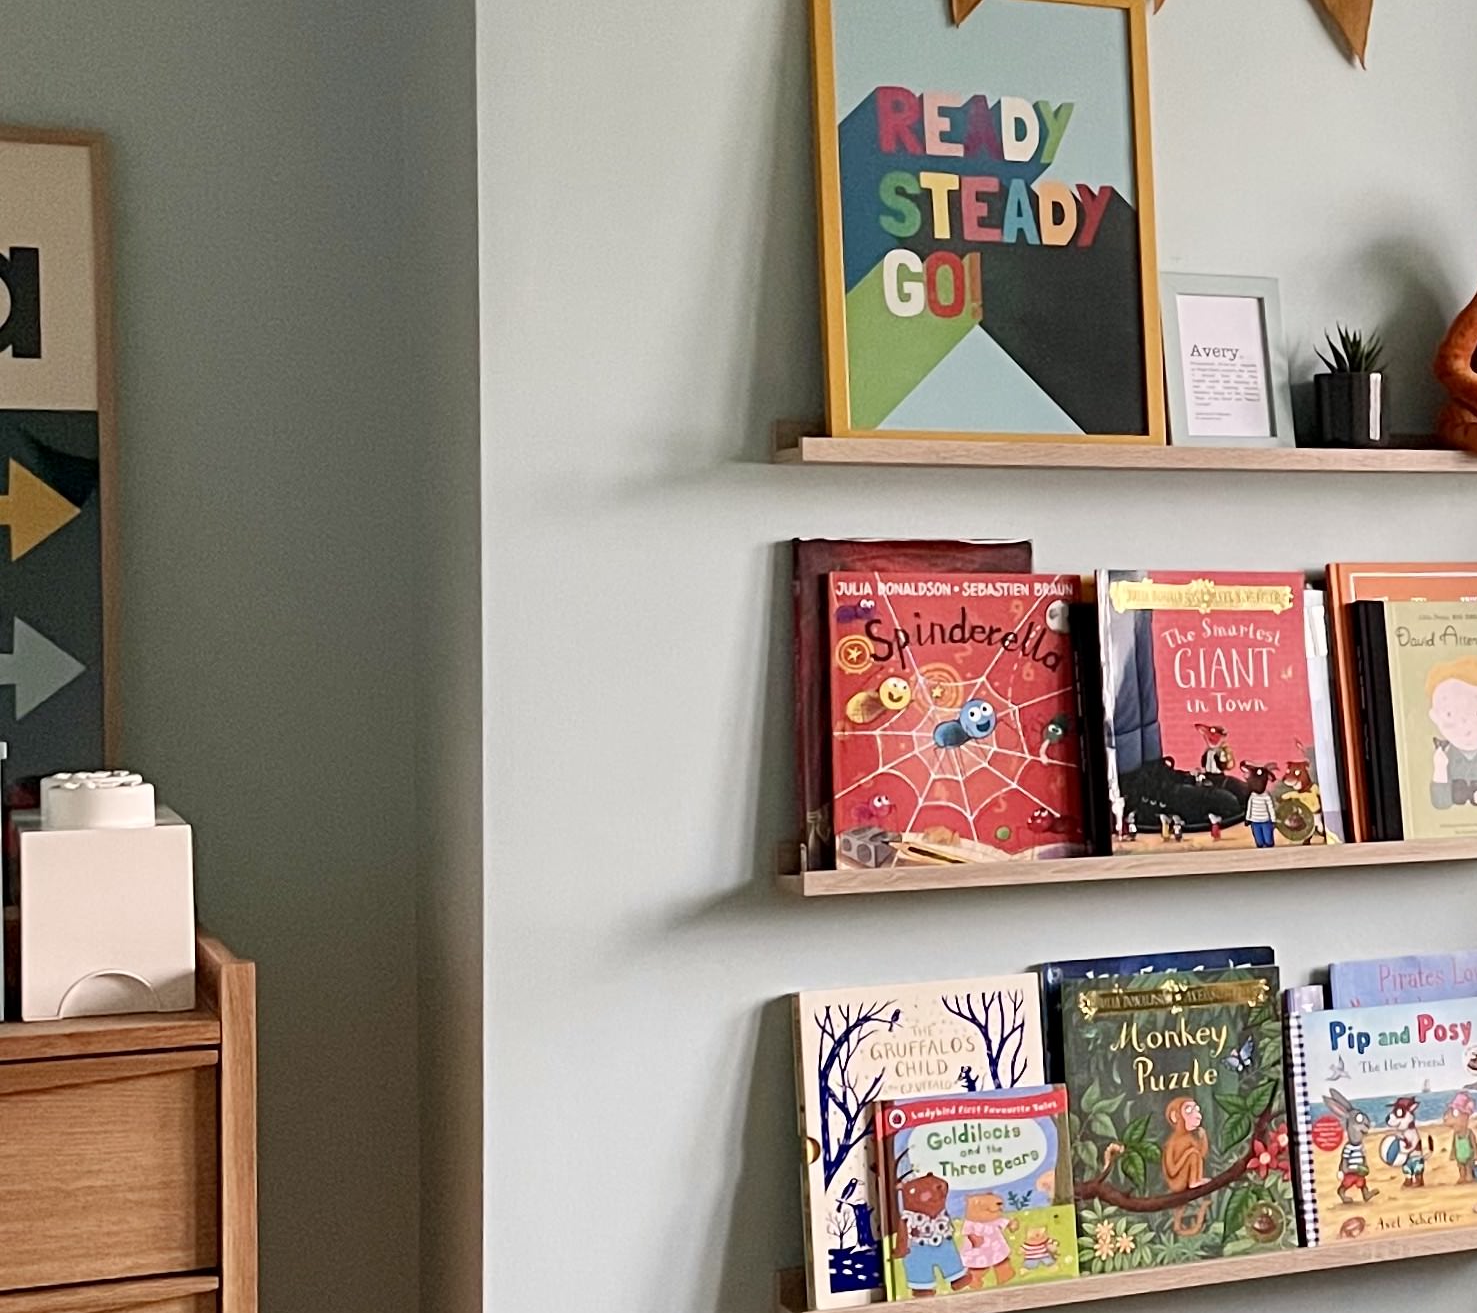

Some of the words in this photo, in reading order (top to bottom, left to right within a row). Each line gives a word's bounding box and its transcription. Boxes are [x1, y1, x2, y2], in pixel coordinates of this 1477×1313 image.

[874, 85, 1075, 165] READY
[877, 171, 1114, 248] STEADY
[882, 247, 983, 322] GO!
[835, 581, 873, 597] JULIA
[877, 581, 951, 597] DONALDSON
[962, 581, 1030, 597] SEBASTIEN
[1034, 581, 1074, 597] BRAUN
[864, 606, 1064, 672] Spinderella
[1160, 627, 1196, 648] The
[1201, 617, 1281, 647] Smartest
[1395, 625, 1436, 647] David
[1173, 646, 1277, 689] GIANT
[1187, 698, 1210, 714] in
[1211, 692, 1269, 714] Town
[1378, 961, 1444, 992] Pirates
[1109, 1016, 1228, 1058] Monkey
[1328, 1020, 1371, 1055] Pip
[1378, 1025, 1411, 1047] and
[1416, 1013, 1473, 1046] Posy
[895, 1059, 948, 1077] CHILD
[1132, 1056, 1219, 1095] Puzzle
[1358, 1060, 1381, 1074] The
[926, 1122, 1021, 1150] Goldilocks
[960, 1145, 981, 1158] and
[939, 1160, 987, 1177] Three
[992, 1150, 1040, 1176] Bears
